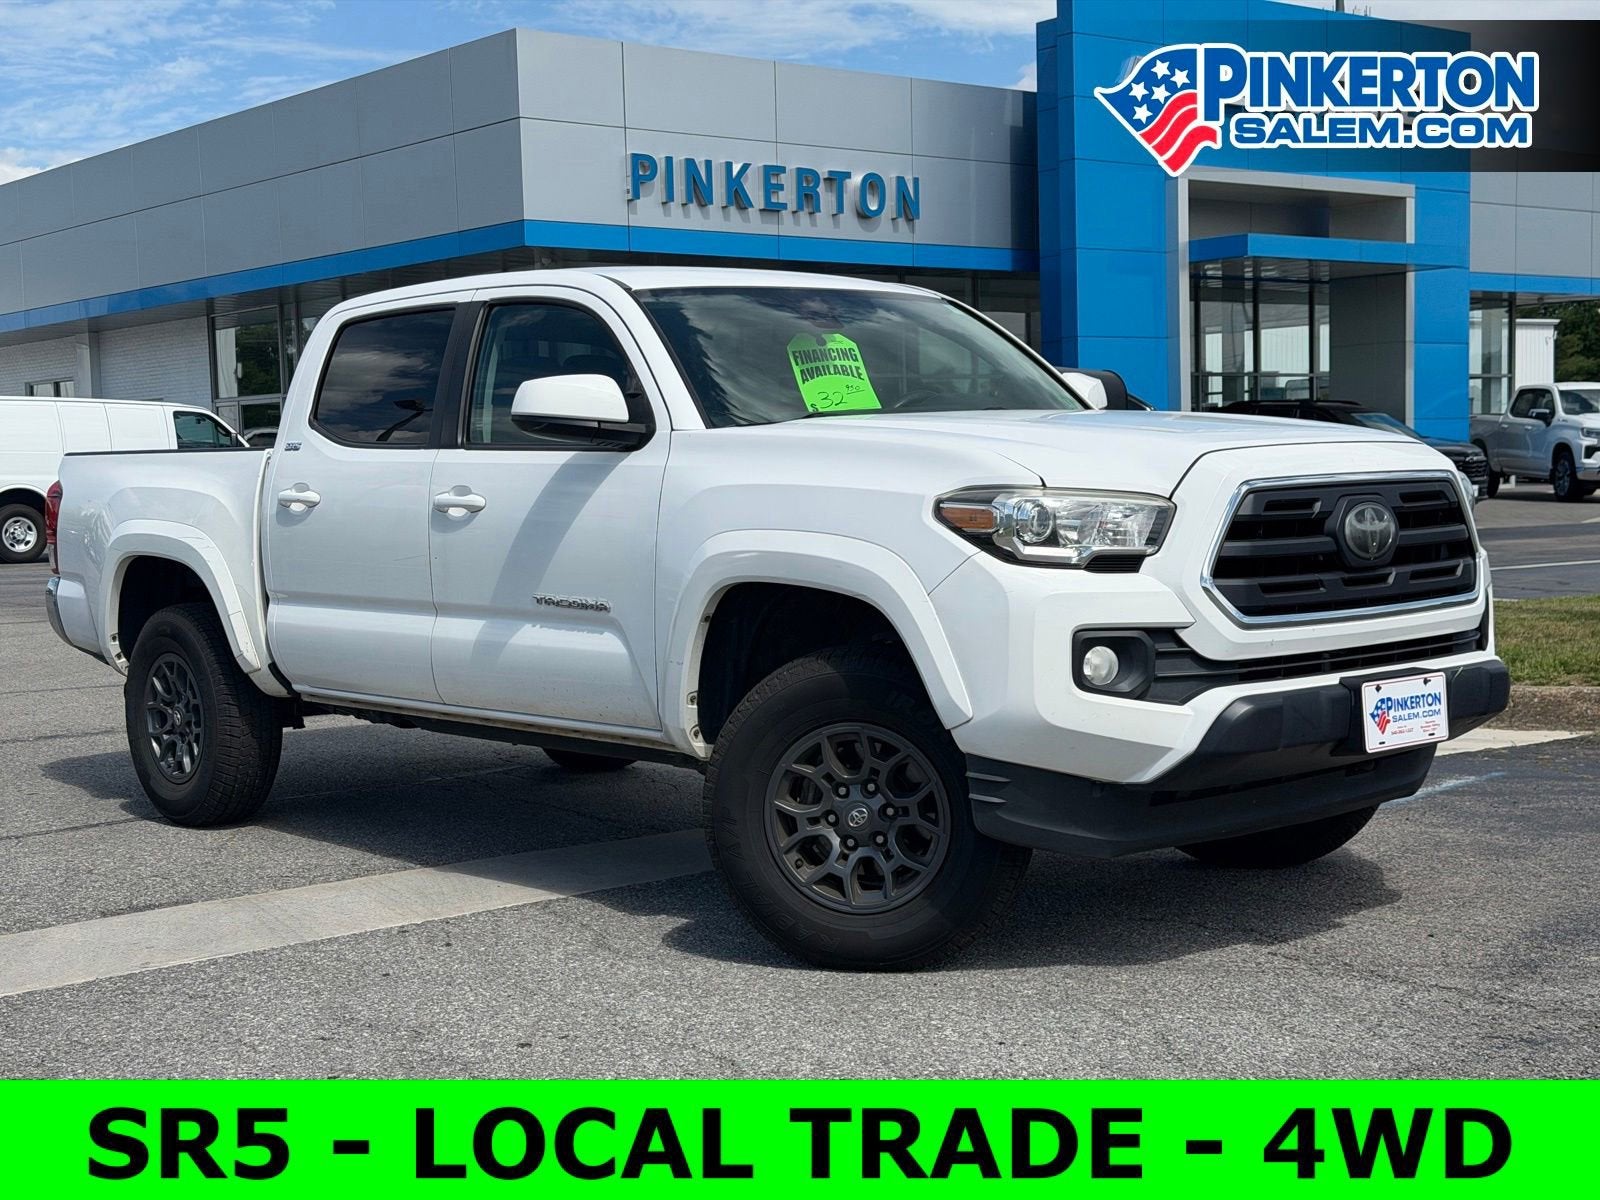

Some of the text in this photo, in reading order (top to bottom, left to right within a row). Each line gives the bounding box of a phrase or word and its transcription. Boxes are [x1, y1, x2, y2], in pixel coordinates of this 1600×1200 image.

[626, 152, 921, 221] PINKERTON
[791, 347, 859, 367] FINANCING
[799, 364, 866, 385] AVAILABLE
[532, 592, 612, 614] TACOMA
[1386, 692, 1442, 717] PINKERTON
[1391, 709, 1442, 723] SALEM.COM
